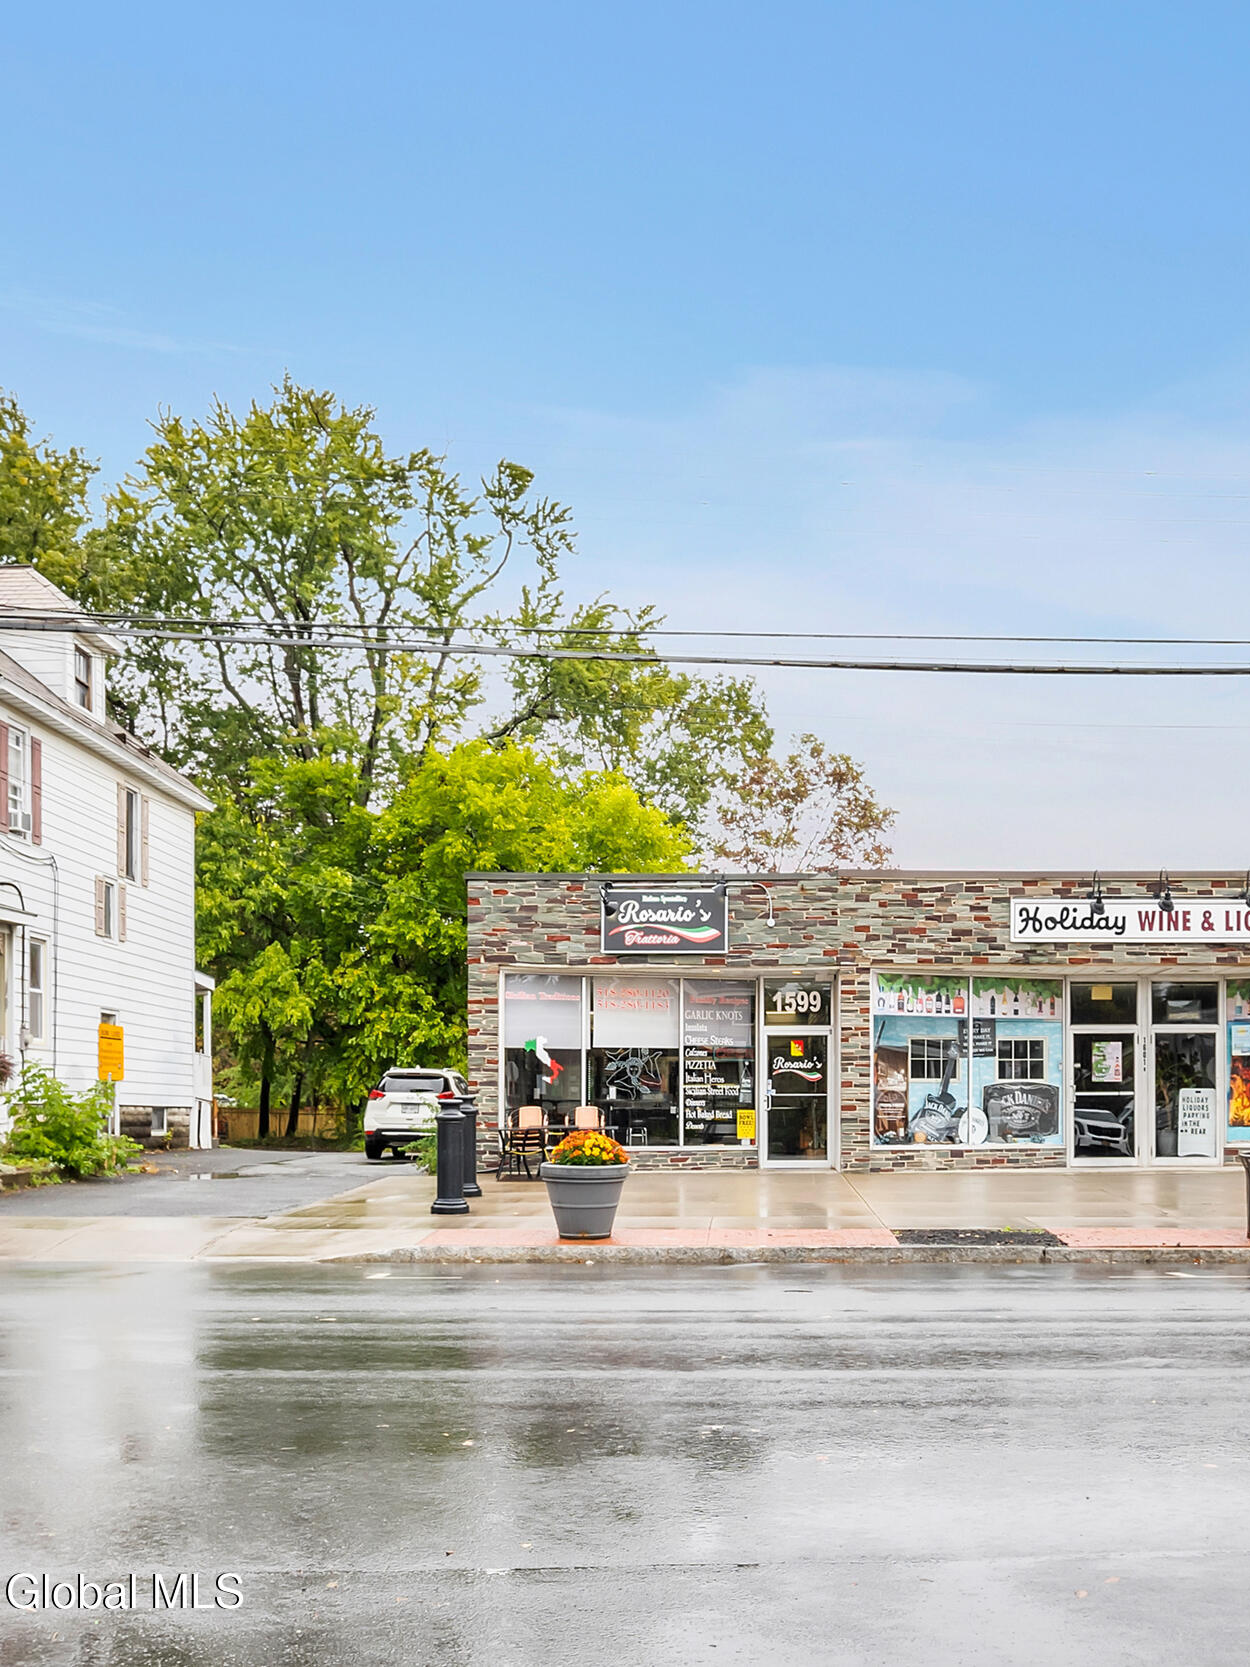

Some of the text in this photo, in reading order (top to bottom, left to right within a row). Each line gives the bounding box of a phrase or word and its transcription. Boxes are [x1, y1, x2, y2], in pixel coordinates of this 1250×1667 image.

[618, 899, 711, 923] Rosario's
[1018, 906, 1127, 935] Holiday
[1137, 910, 1192, 932] WINE
[1200, 910, 1215, 932] &
[624, 930, 680, 946] Trattoria
[772, 991, 821, 1012] 1599
[685, 1010, 743, 1020] GARLIC KNOTS
[772, 1056, 822, 1069] Rosario's
[685, 1072, 725, 1084] Italian Heros
[725, 1086, 739, 1095] Food
[685, 1109, 696, 1118] Hot
